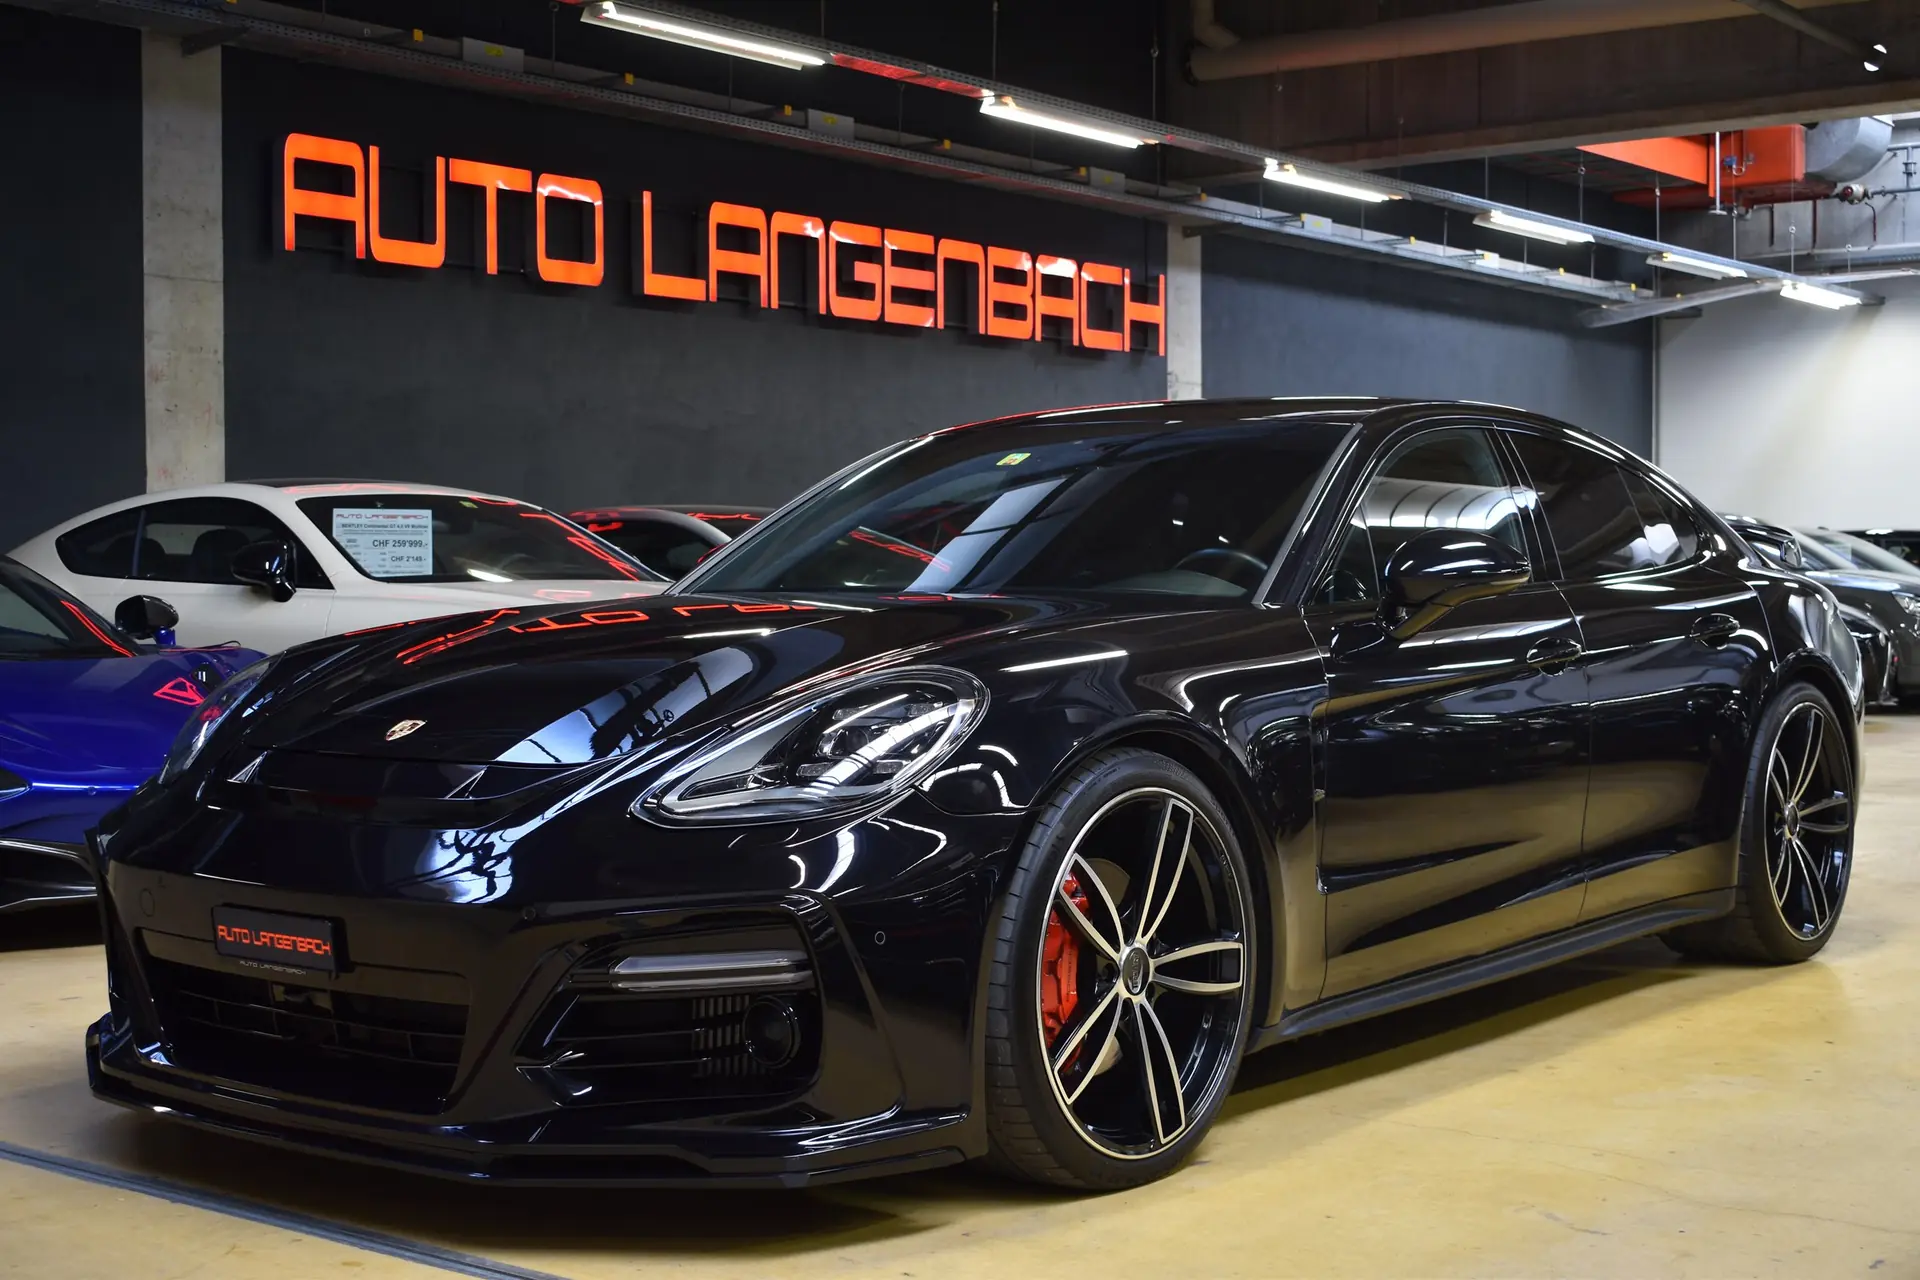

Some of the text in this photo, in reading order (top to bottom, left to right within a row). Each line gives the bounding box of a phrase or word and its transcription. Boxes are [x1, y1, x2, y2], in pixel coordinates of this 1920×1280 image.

[284, 133, 1166, 357] AUTO LANGENBACH
[372, 539, 391, 548] CHF
[217, 925, 332, 956] AUTO LANGENBACH
[239, 960, 258, 968] AUTO
